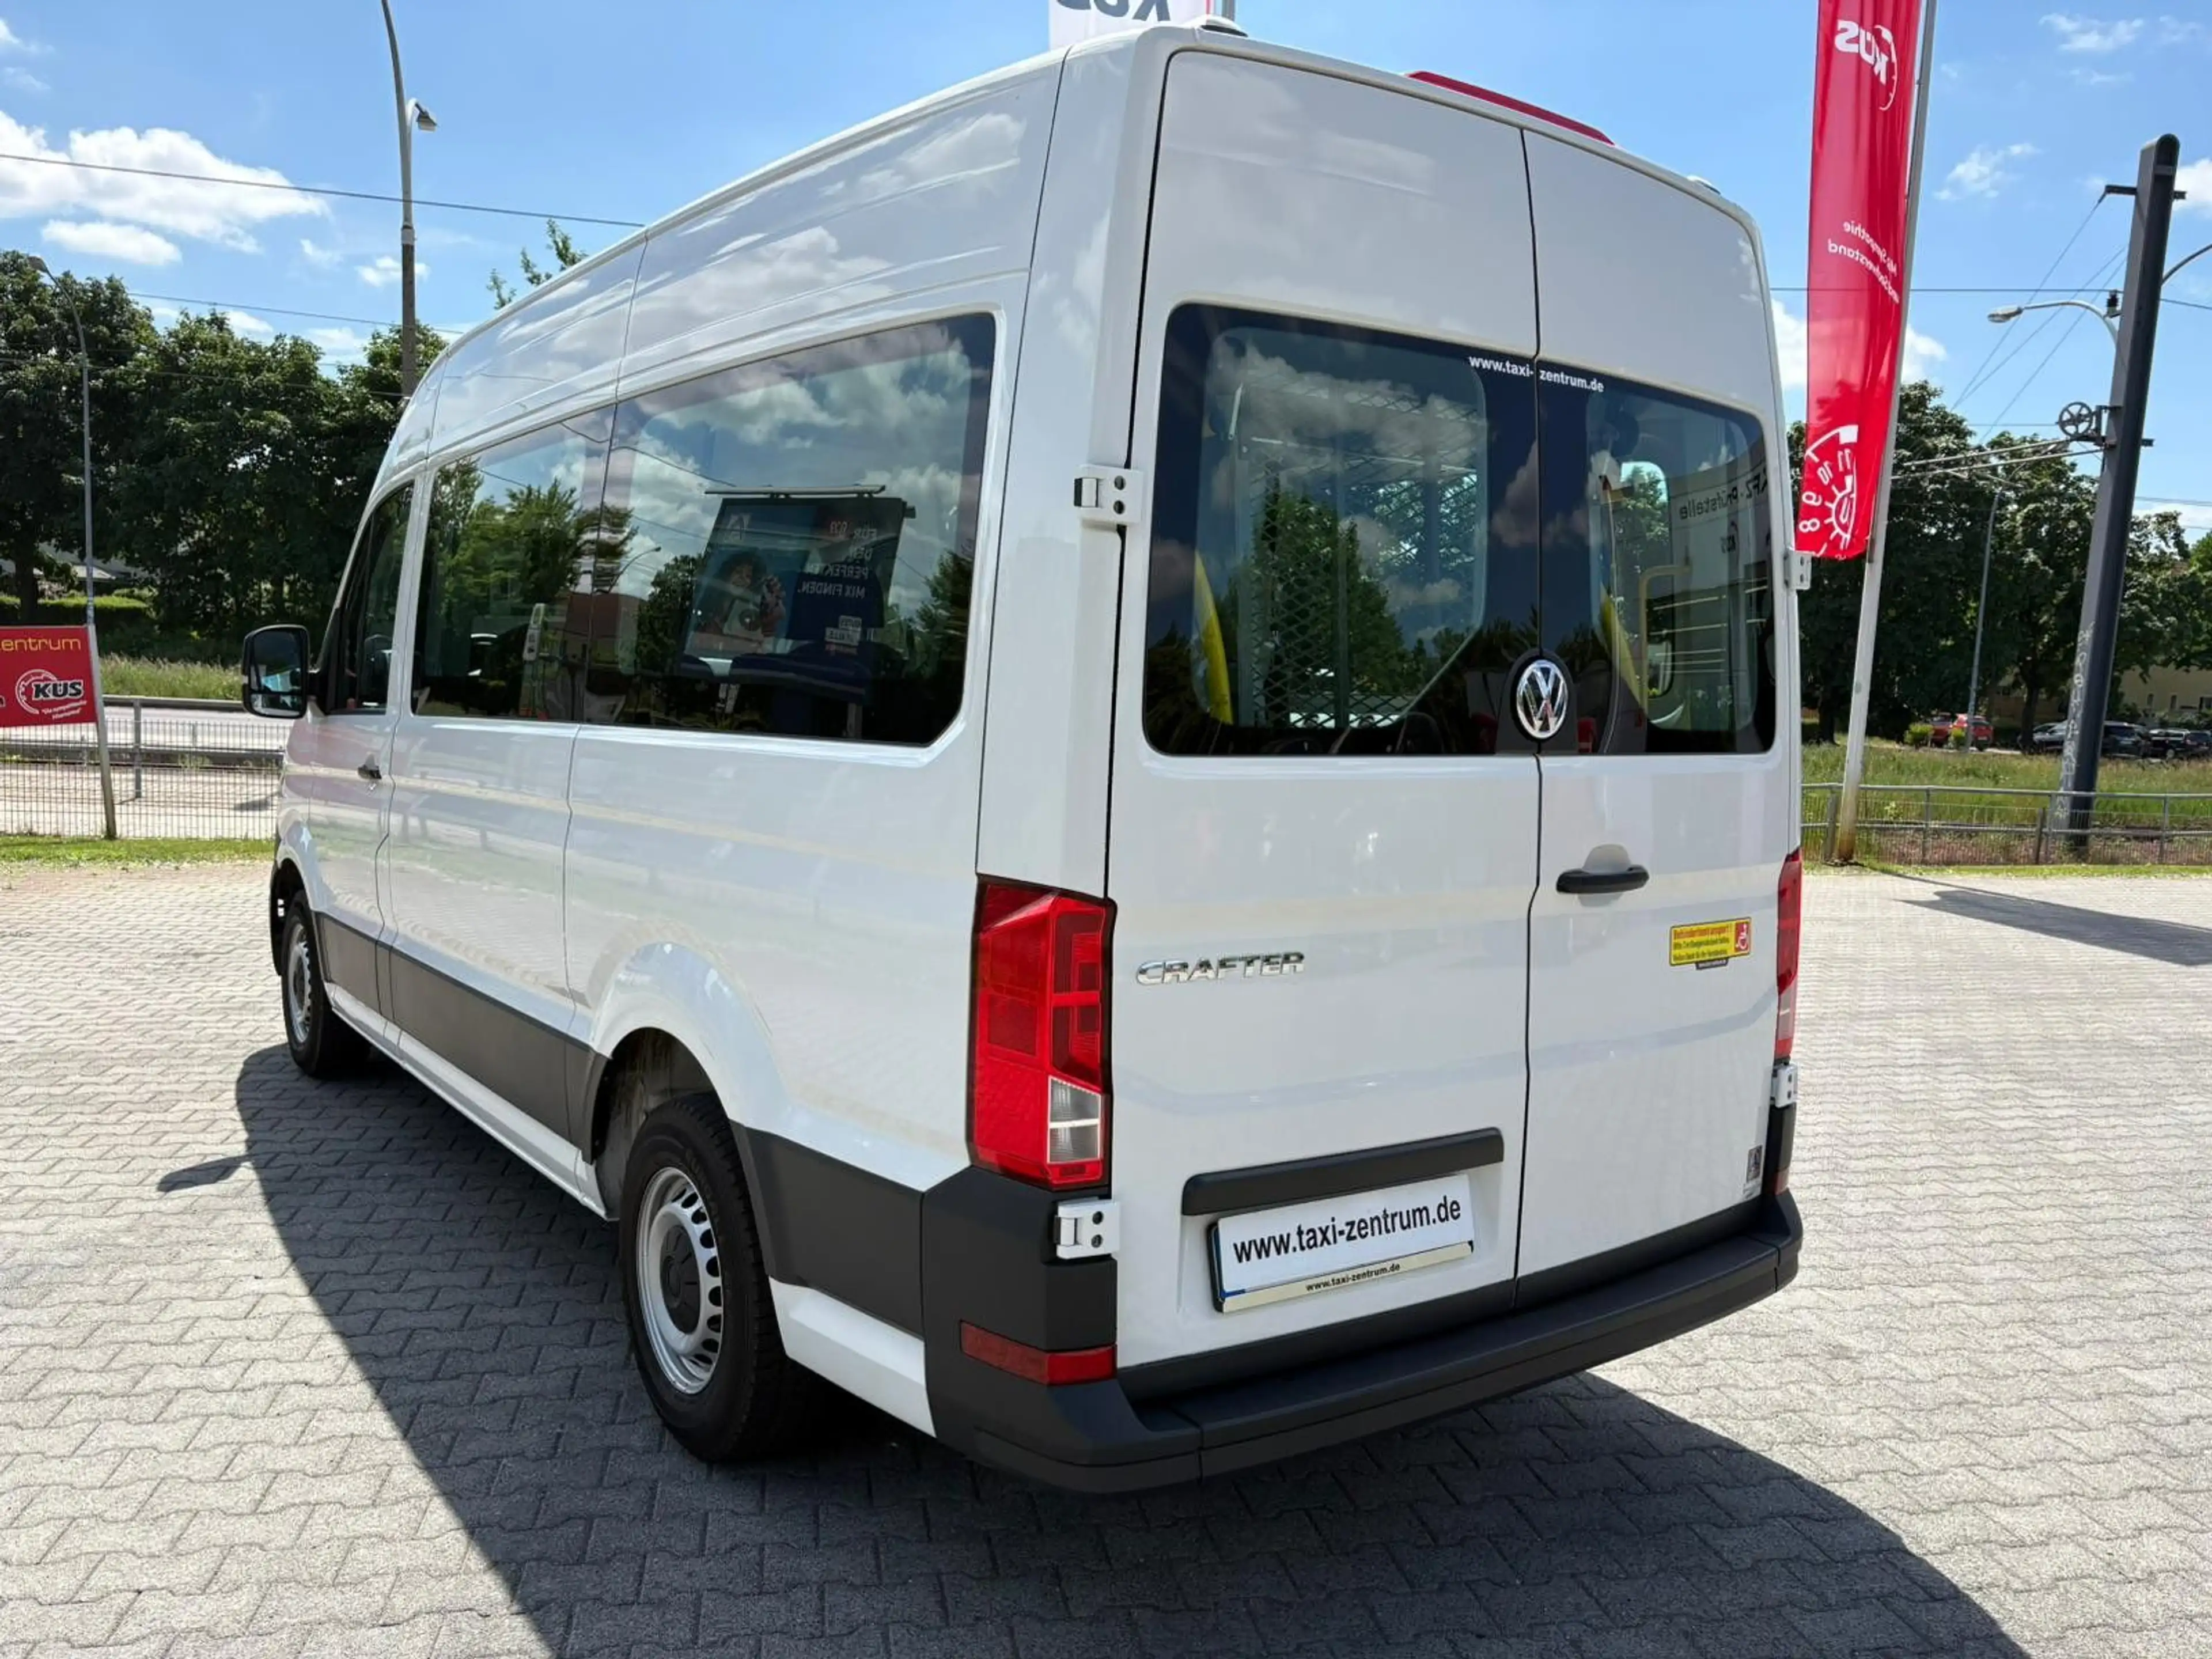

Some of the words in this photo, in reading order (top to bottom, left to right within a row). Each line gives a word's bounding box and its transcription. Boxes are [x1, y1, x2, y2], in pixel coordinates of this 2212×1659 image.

[0, 637, 81, 652] entrum
[1136, 951, 1305, 986] CRAFTER
[1233, 1194, 1461, 1263] www.taxi-zentrum.de
[1305, 1262, 1401, 1292] www.taxi-zentrum.de
